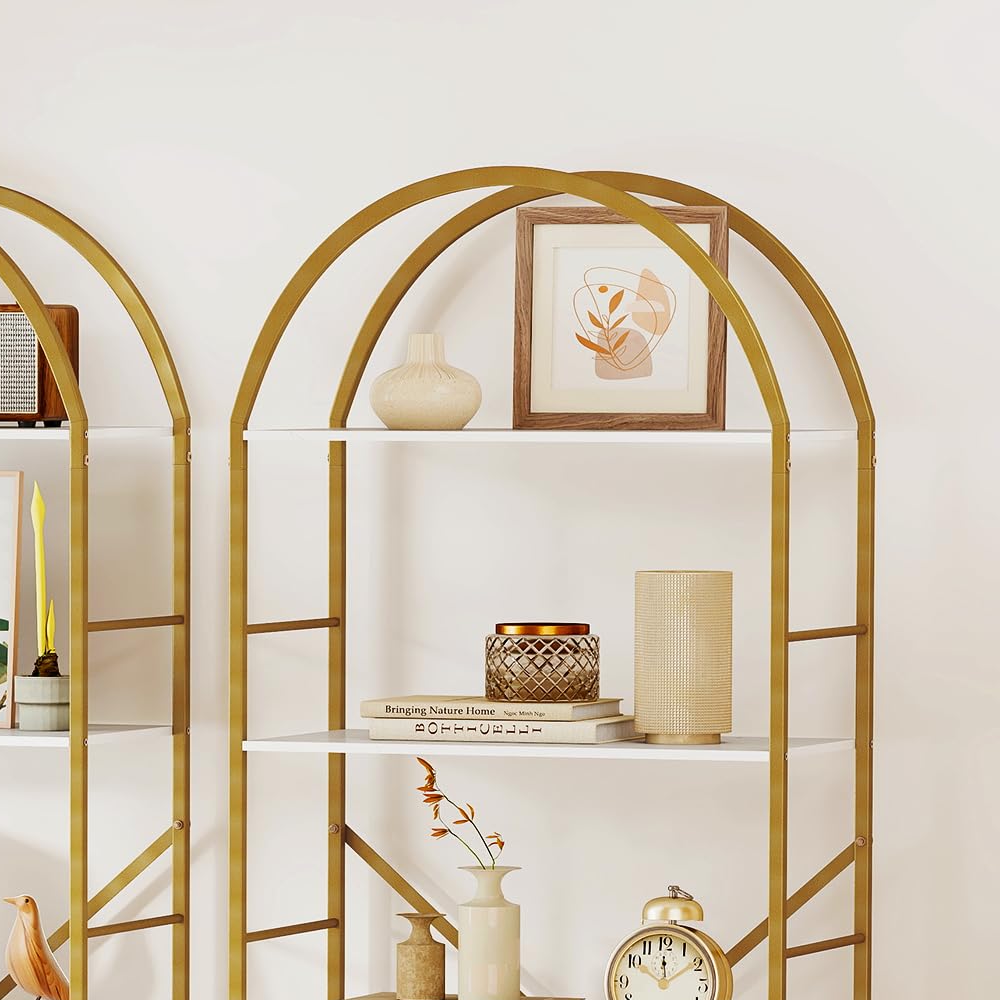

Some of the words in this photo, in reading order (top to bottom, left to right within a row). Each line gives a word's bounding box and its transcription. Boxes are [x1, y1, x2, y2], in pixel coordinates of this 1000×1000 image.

[385, 705, 427, 716] Bringing
[429, 706, 464, 715] Nature
[466, 706, 496, 715] Home
[415, 721, 542, 735] BOTTICELLI
[642, 940, 652, 955] 11
[659, 936, 673, 951] 12
[682, 942, 687, 957] 1
[628, 954, 642, 968] 10
[693, 957, 703, 972] 2
[620, 975, 629, 989] 9
